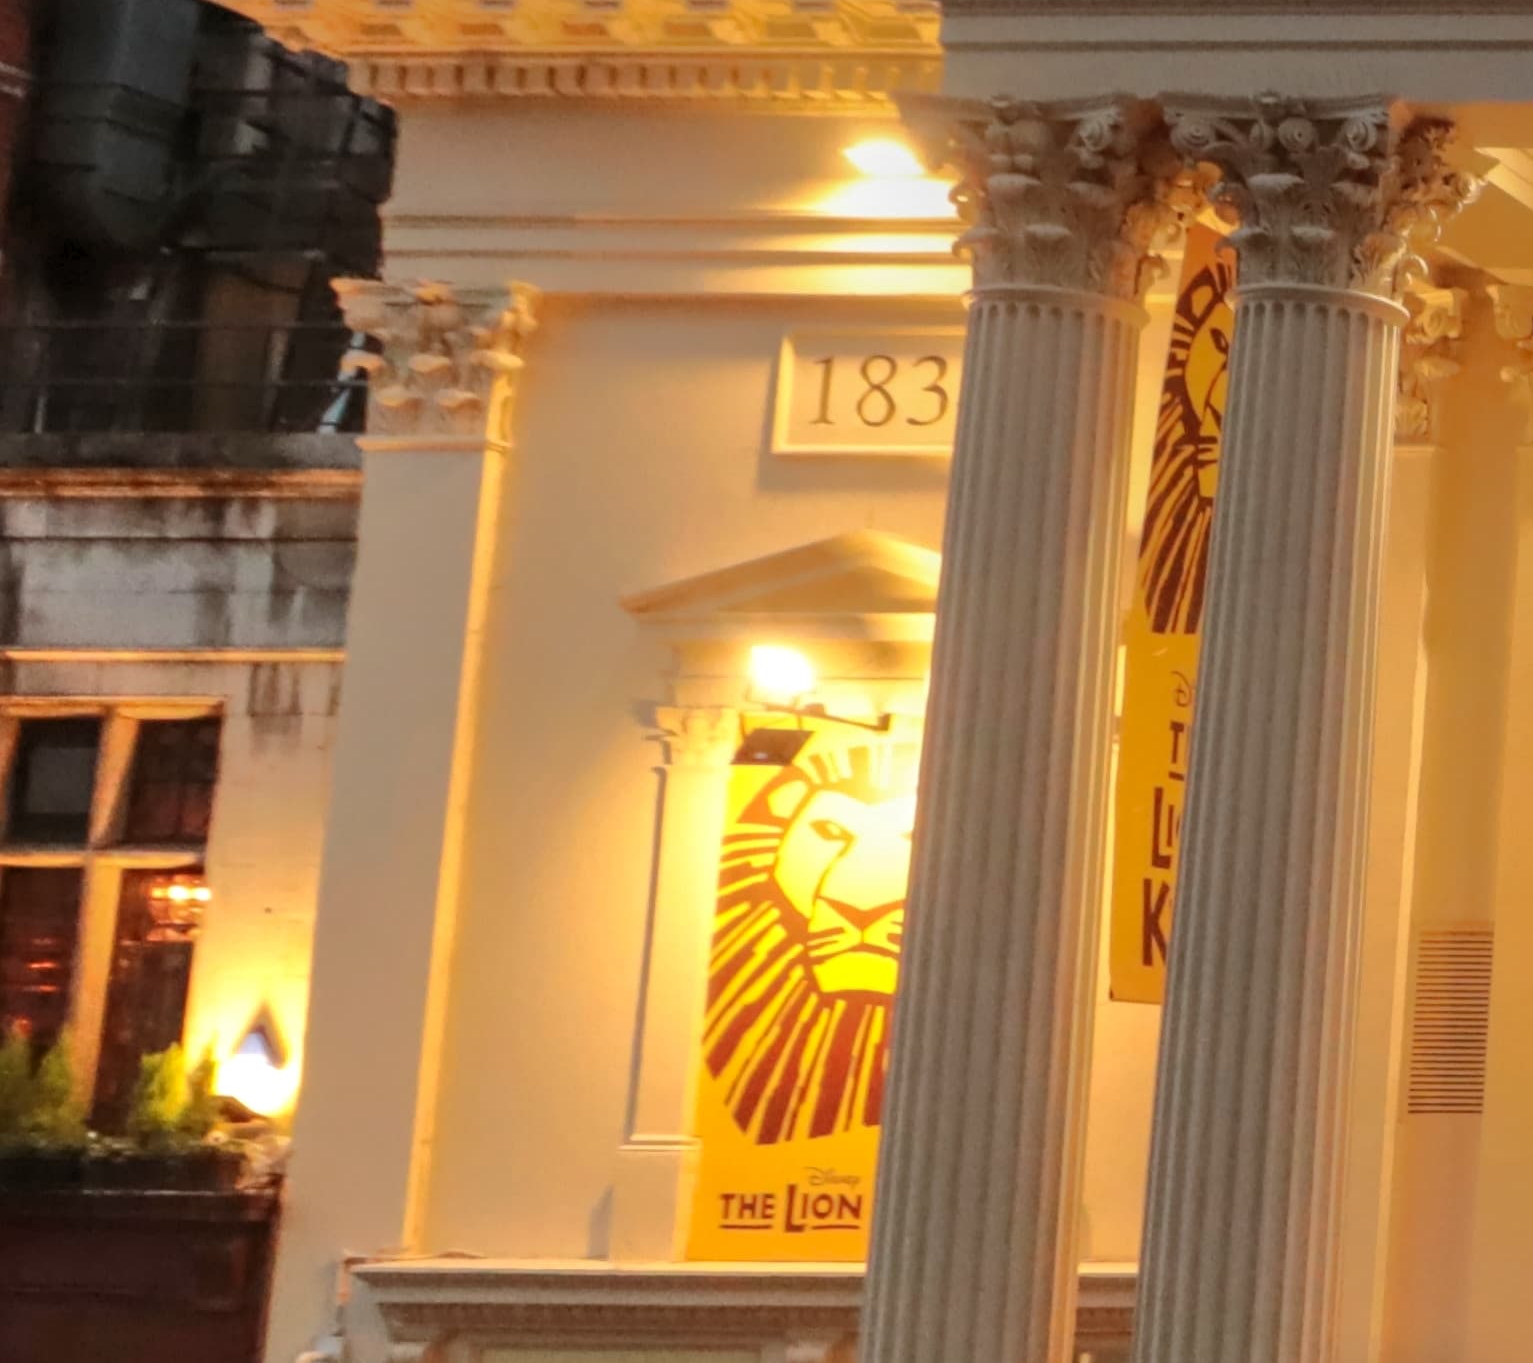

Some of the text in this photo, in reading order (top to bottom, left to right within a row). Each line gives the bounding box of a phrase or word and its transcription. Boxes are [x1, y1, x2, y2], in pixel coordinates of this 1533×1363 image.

[808, 354, 949, 427] 183
[720, 1184, 862, 1233] THE LION
